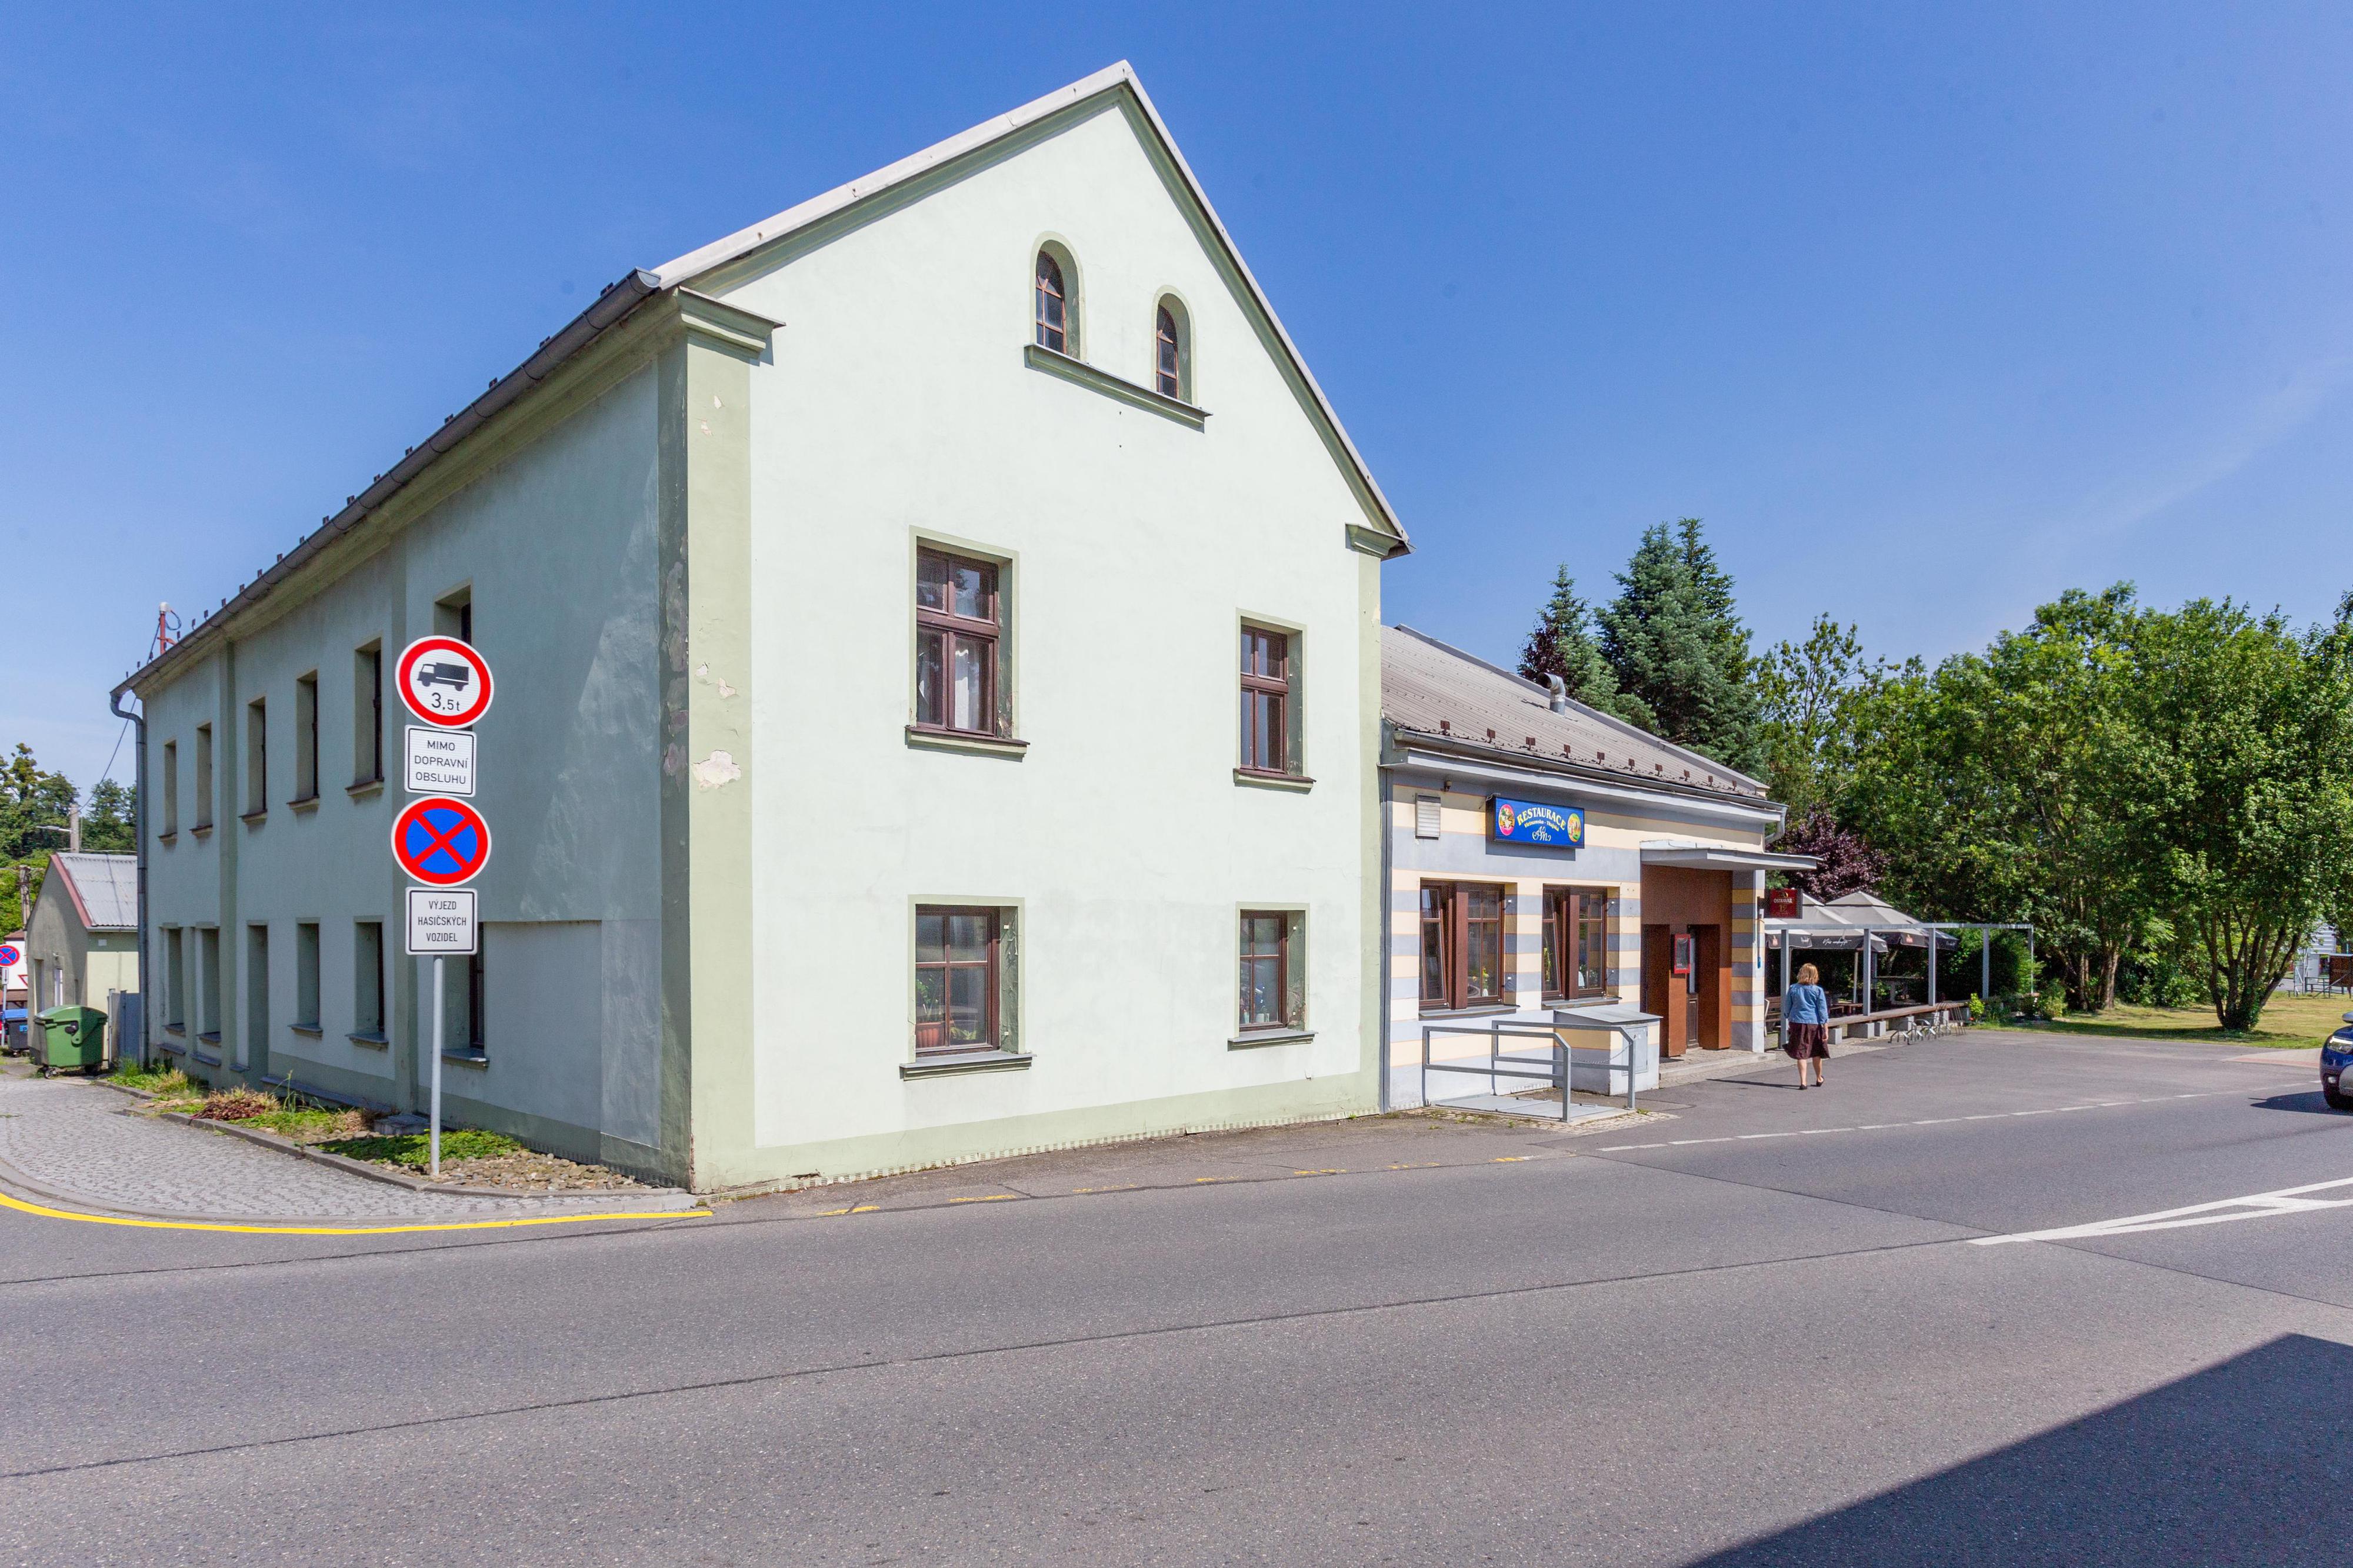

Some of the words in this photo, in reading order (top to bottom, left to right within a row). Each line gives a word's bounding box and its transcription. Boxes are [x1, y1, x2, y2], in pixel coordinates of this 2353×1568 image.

[427, 740, 455, 751] MIMO
[414, 755, 469, 769] DOPRAVNÍ
[415, 772, 466, 785] OBSLUHU
[1517, 807, 1567, 830] RESTAURACE
[428, 899, 457, 910] VÝJEZD
[418, 915, 466, 926] HASIČSKÝCH
[426, 932, 458, 942] VOZIDEL
